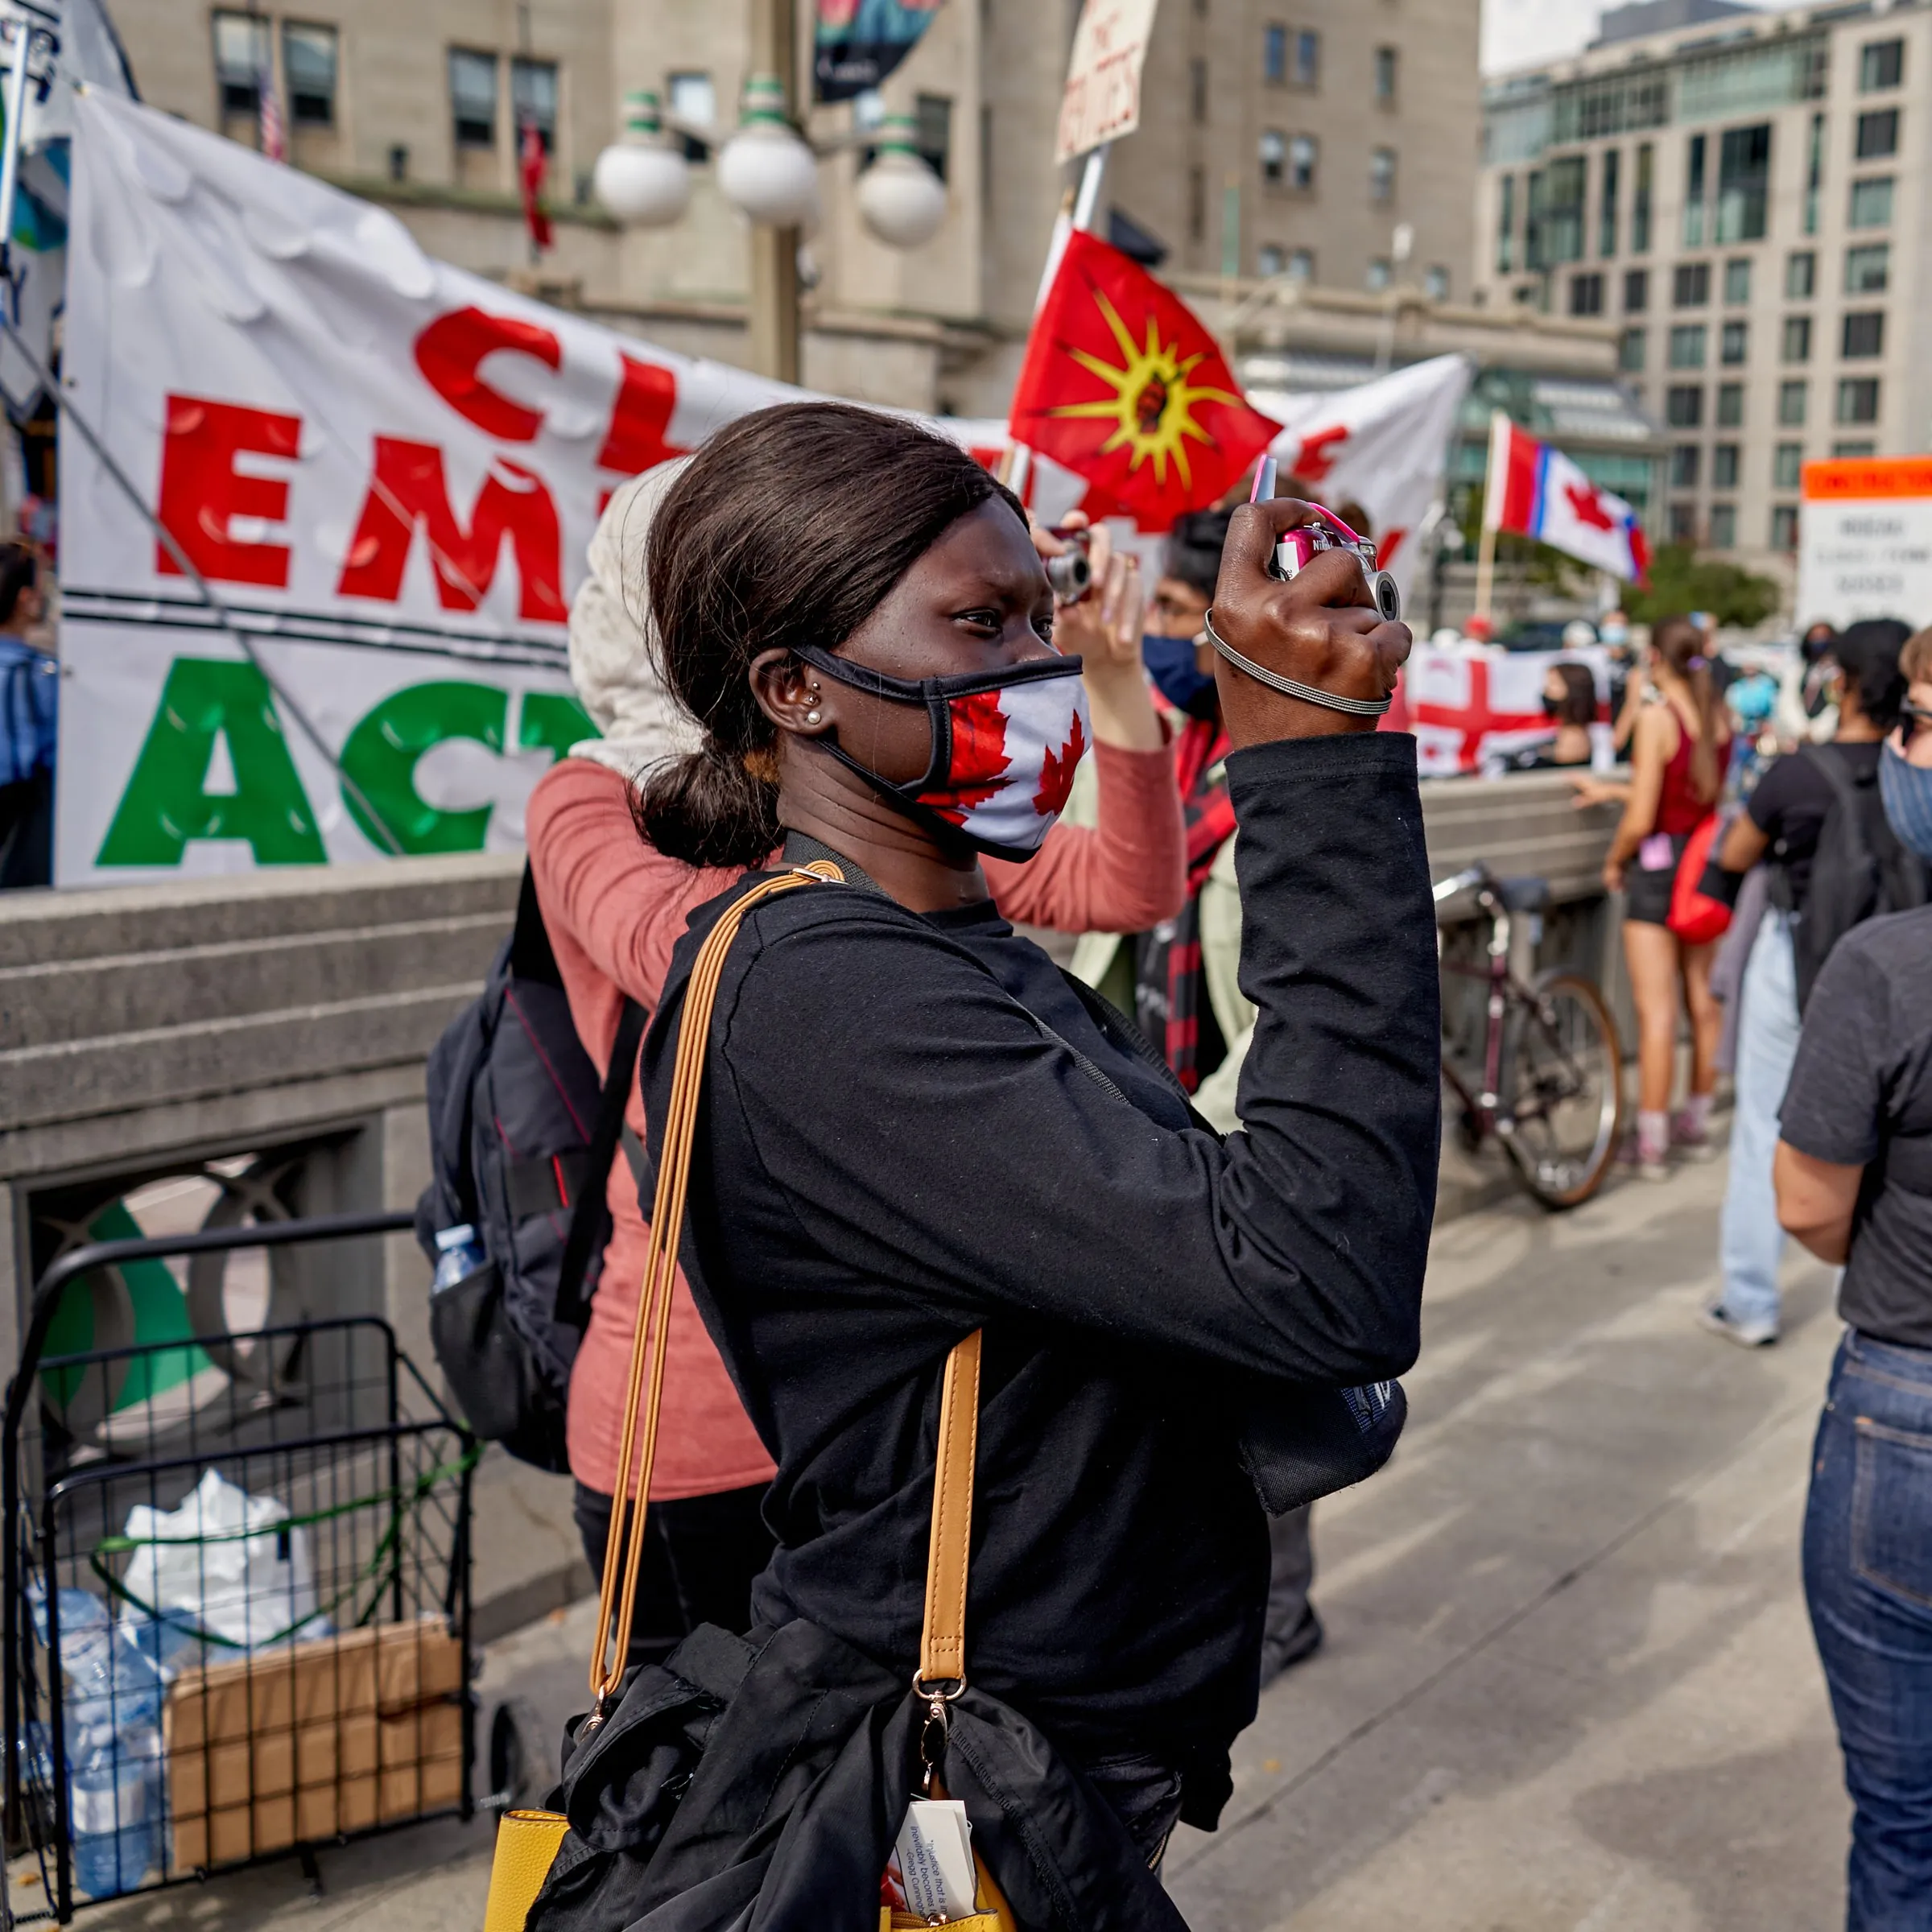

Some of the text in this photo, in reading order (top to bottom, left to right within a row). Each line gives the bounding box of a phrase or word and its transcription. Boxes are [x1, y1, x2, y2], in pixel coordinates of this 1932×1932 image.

[910, 1826, 927, 1866] inevitably
[920, 1868, 935, 1907] becomes
[911, 1877, 926, 1917] Cunningha
[935, 1878, 946, 1896] that
